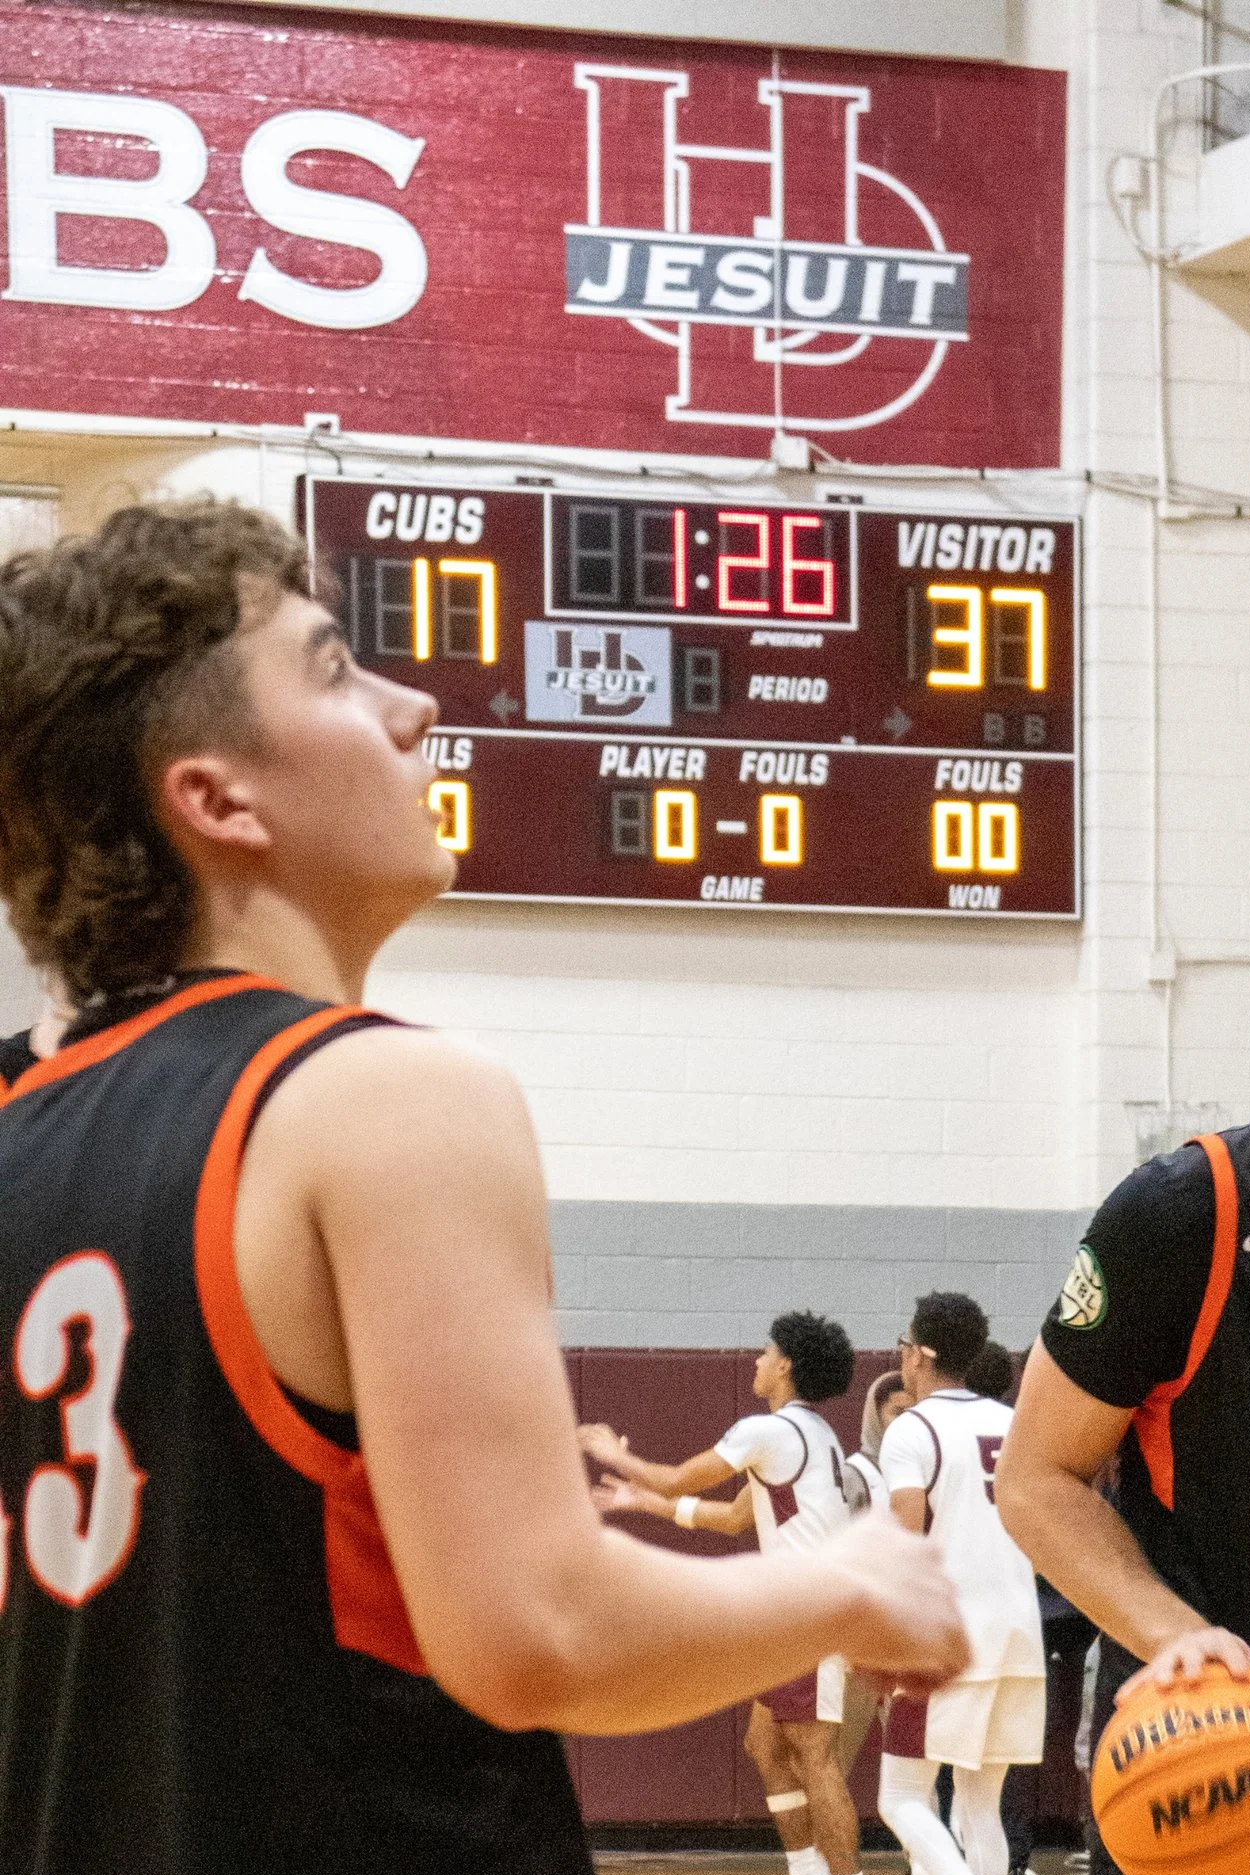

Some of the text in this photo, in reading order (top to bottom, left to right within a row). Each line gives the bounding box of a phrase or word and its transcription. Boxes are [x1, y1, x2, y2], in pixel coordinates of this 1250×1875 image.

[576, 240, 957, 326] JESUIT
[366, 492, 485, 546] CUBS
[673, 508, 835, 615] 1:26
[898, 521, 1056, 574] VISITOR
[412, 557, 497, 664] 17
[926, 584, 1047, 690] 37
[548, 671, 653, 693] JESUIT
[748, 675, 830, 704] PERIOD
[421, 737, 473, 769] ULS
[599, 745, 829, 786] PLAYER FOULS
[934, 759, 1024, 793] FOULS
[932, 800, 1020, 874] 00
[701, 875, 764, 901] GAME
[948, 885, 1001, 910] WON
[0, 1250, 148, 1608] 3
